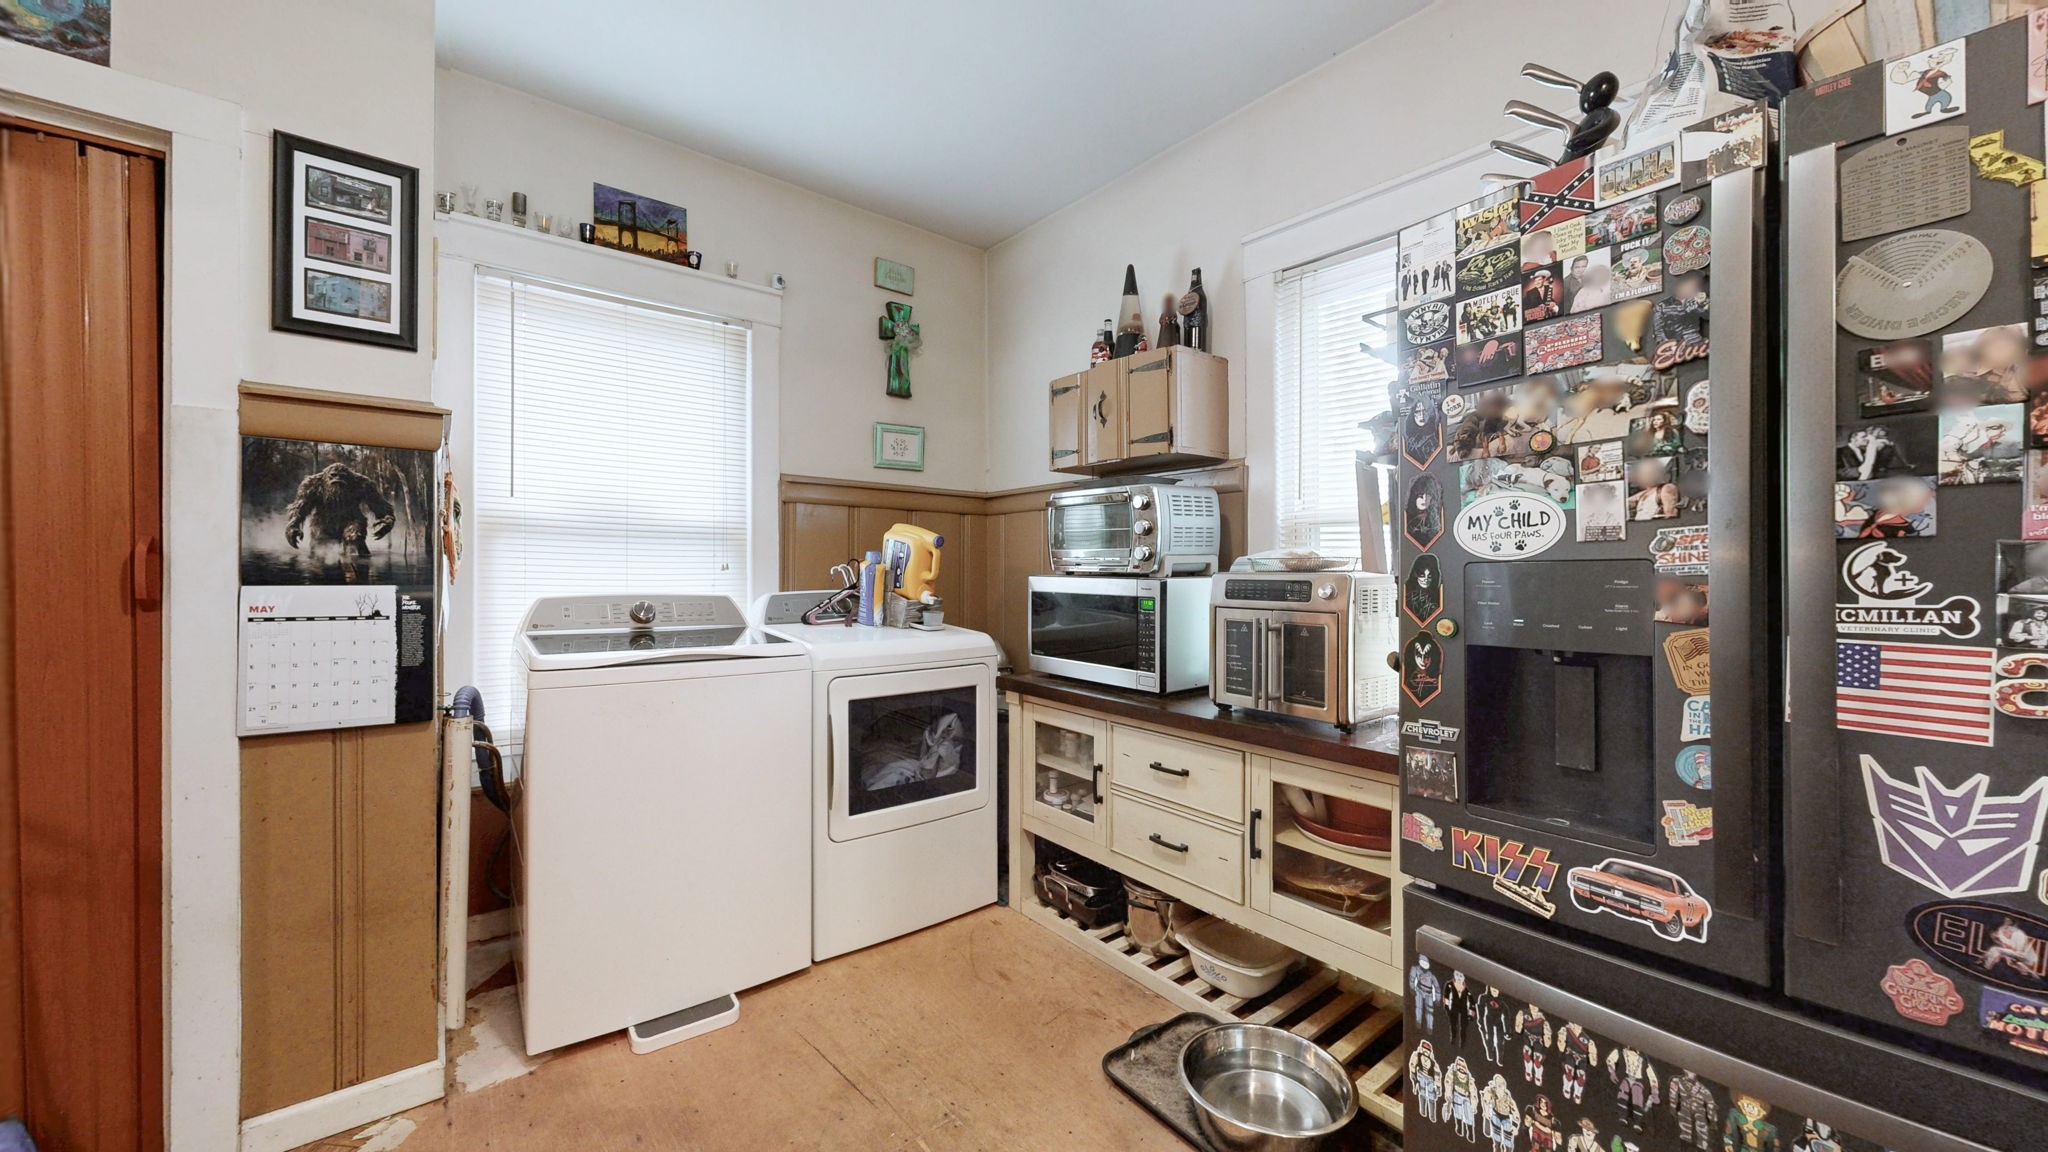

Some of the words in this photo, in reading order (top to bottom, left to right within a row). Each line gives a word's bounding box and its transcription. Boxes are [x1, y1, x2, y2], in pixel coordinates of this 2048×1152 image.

[1621, 240, 1641, 252] FUCK
[1641, 236, 1650, 245] IT
[1410, 303, 1446, 320] LYNYRD
[1408, 325, 1449, 344] SKYNYRD
[1655, 339, 1709, 370] Elvi
[1446, 402, 1462, 415] PORN
[1468, 514, 1492, 532] MY
[1498, 511, 1551, 529] CHILD
[1472, 533, 1488, 541] HAS
[1675, 534, 1709, 545] SPE
[249, 605, 275, 613] MAY
[1836, 609, 1963, 624] CMILLAN
[1840, 625, 1900, 633] VETERINARY
[1695, 670, 1709, 678] W
[1687, 700, 1710, 711] CA
[1407, 725, 1454, 738] CHEVROLET
[1689, 724, 1710, 735] HA
[1451, 826, 1560, 893] KISS
